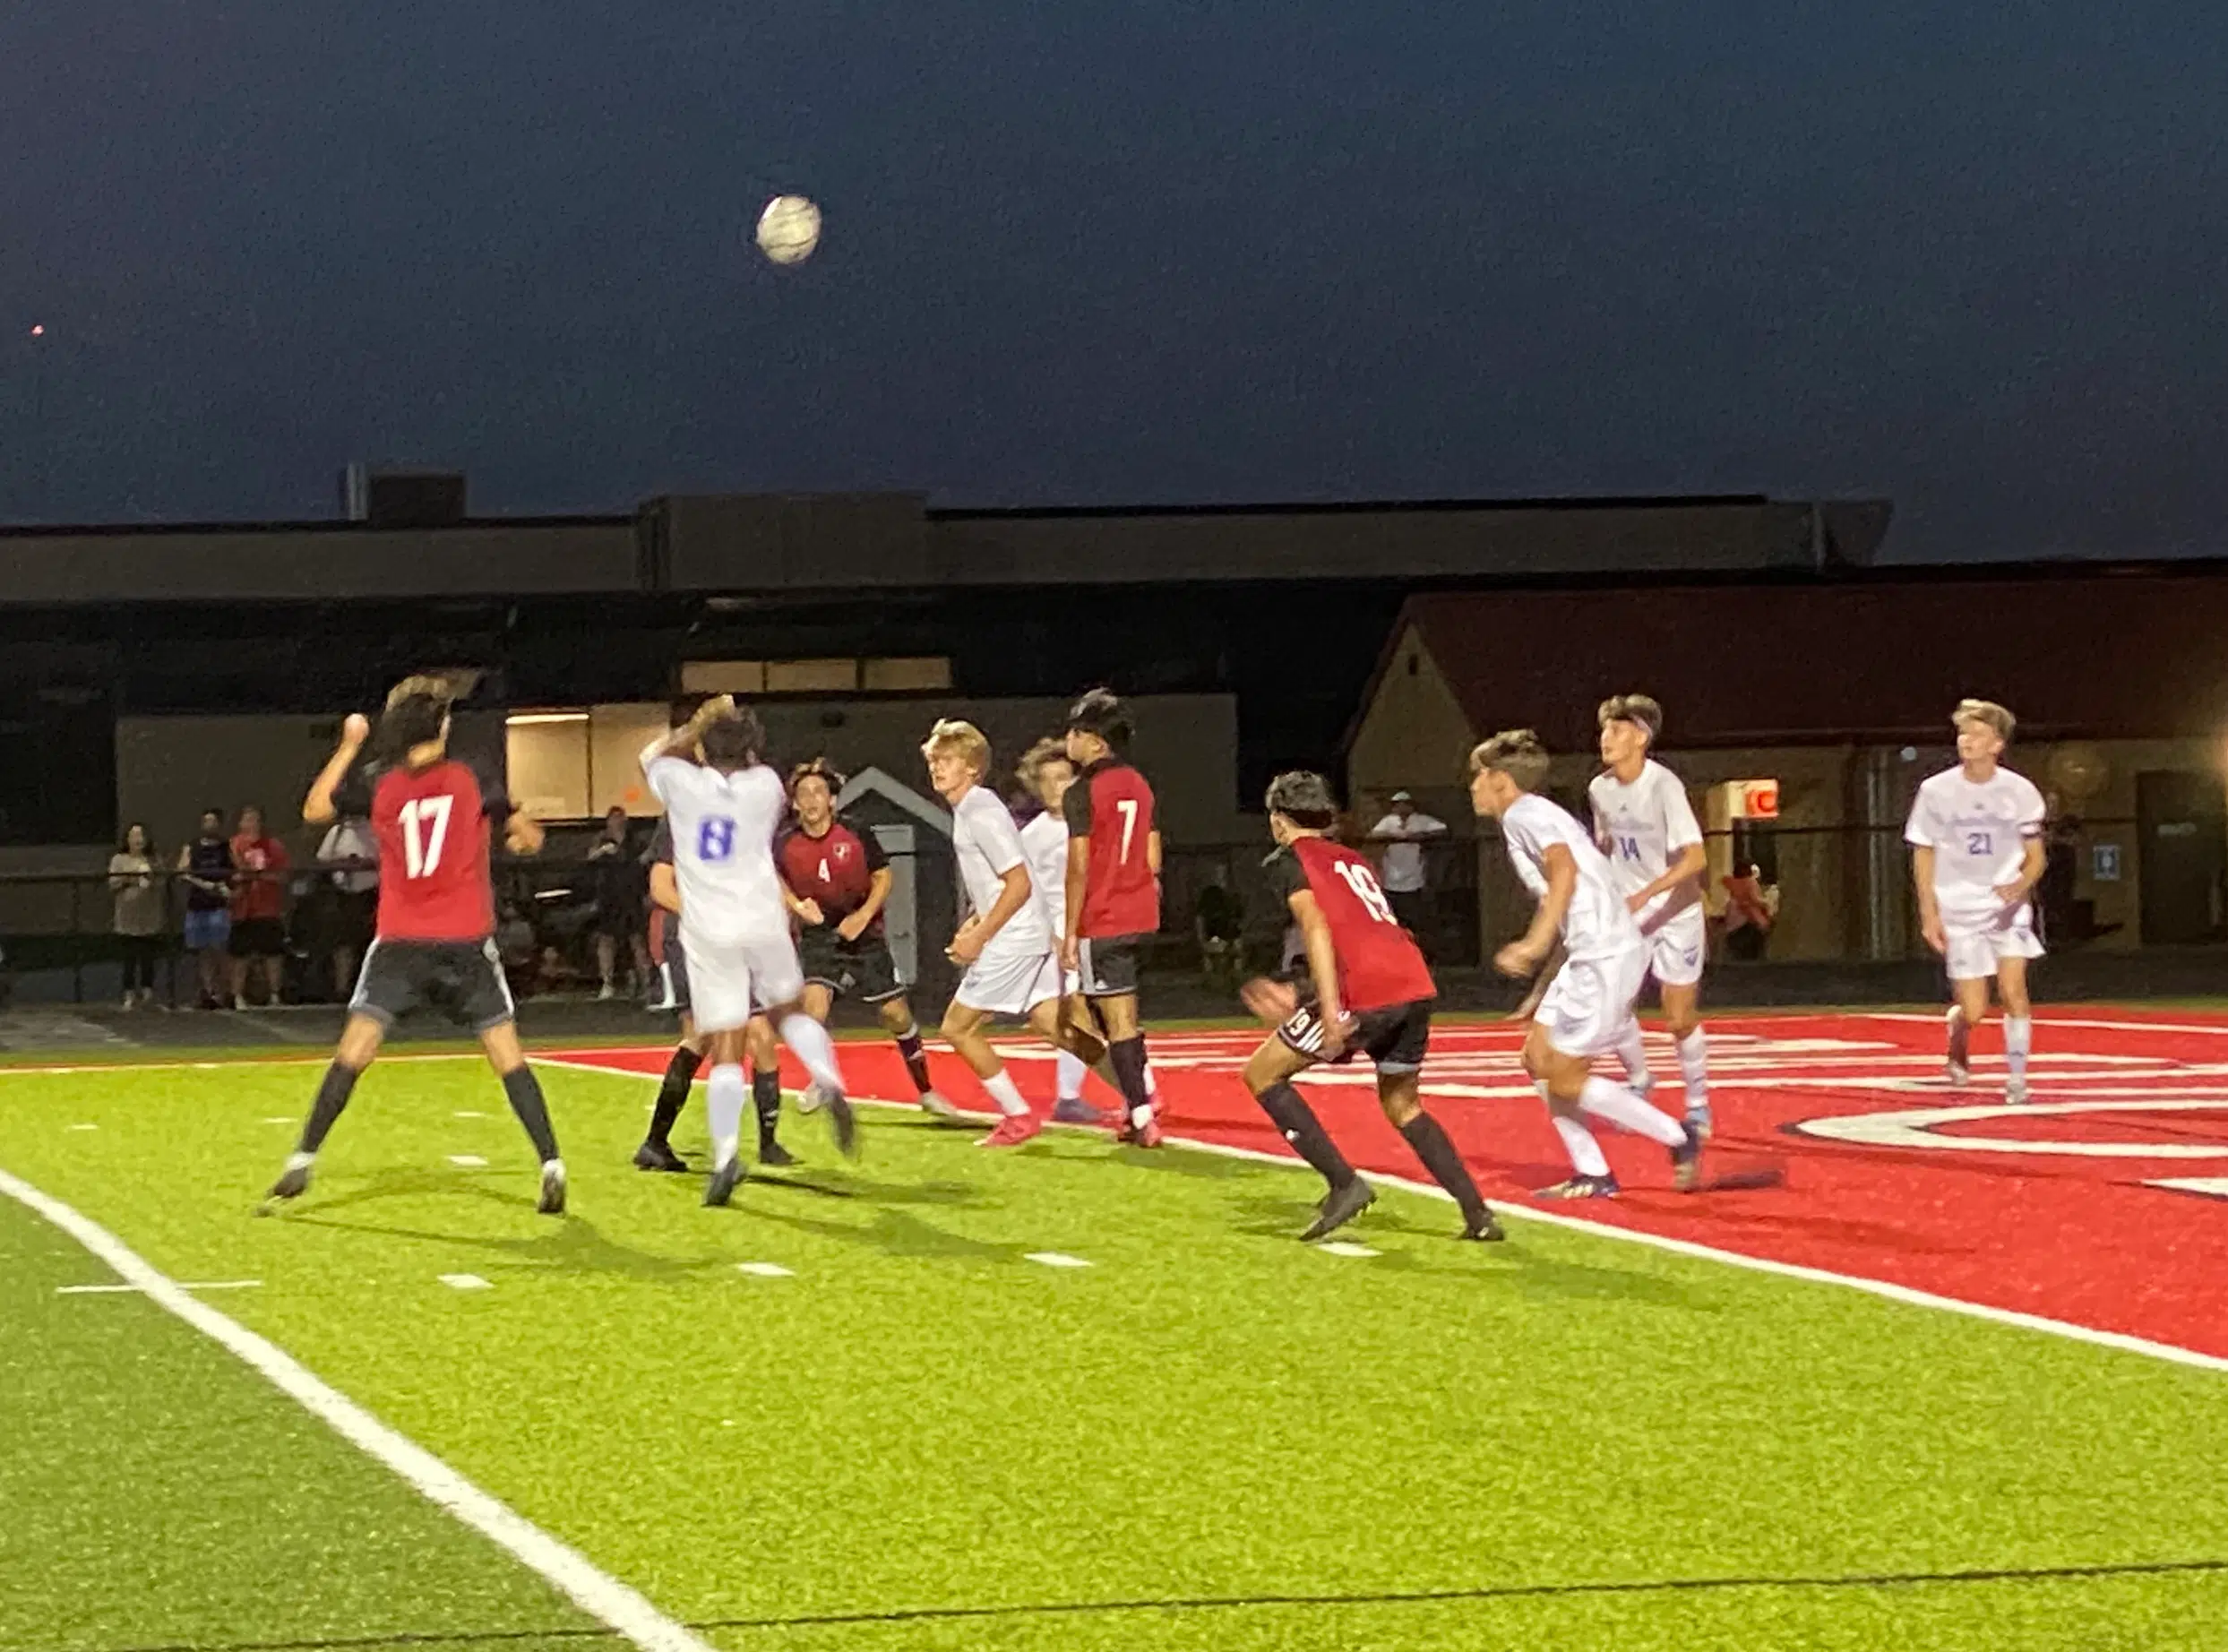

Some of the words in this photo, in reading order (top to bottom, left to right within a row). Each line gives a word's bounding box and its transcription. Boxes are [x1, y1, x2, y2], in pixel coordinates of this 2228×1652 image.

[398, 795, 454, 880] 17
[1117, 800, 1139, 865] 7
[1967, 832, 1993, 856] 21
[1620, 837, 1641, 862] 14
[818, 858, 831, 883] 4
[1334, 860, 1398, 926] 19
[1286, 1007, 1311, 1037] 19
